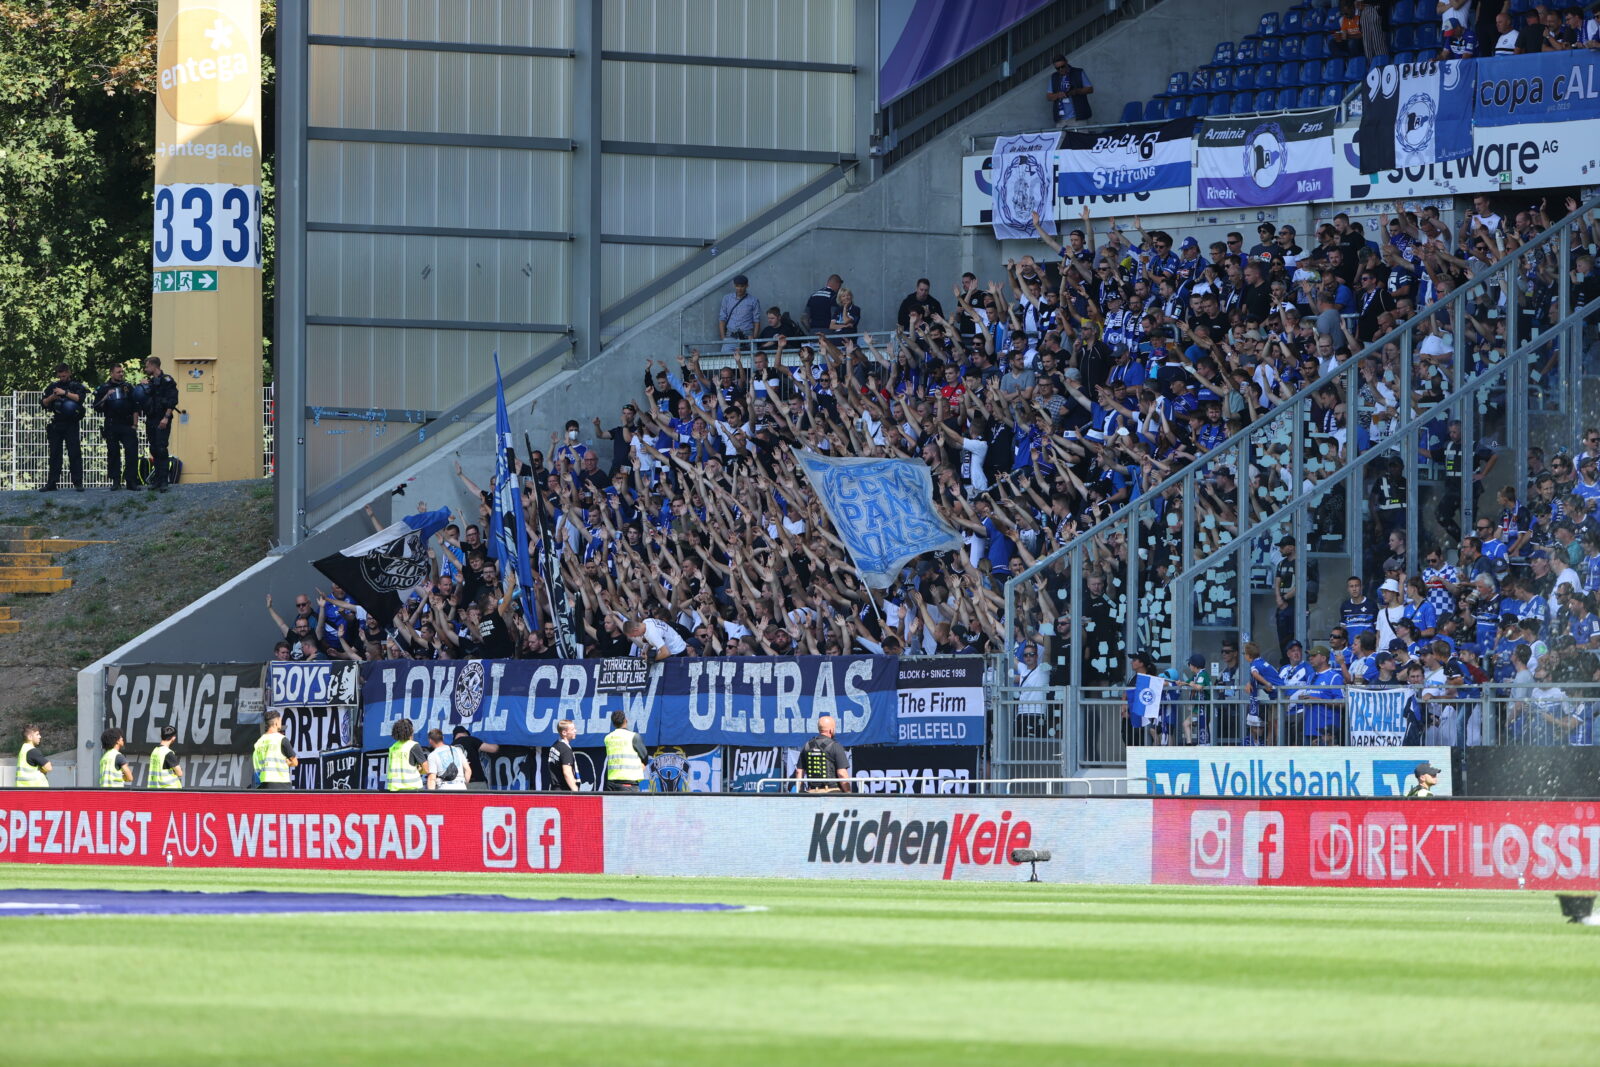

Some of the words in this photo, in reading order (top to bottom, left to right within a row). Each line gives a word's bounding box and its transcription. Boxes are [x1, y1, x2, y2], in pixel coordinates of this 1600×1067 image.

[161, 52, 249, 90] entega
[1366, 64, 1399, 101] 90
[1402, 60, 1437, 80] PLUS
[1480, 75, 1543, 113] copa
[1205, 127, 1246, 140] Arminia
[1298, 121, 1324, 133] Fans
[1542, 140, 1559, 153] AG
[168, 141, 253, 160] entega.de
[1297, 178, 1321, 193] Main
[633, 658, 648, 670] ALS
[899, 669, 921, 679] BLOCK
[921, 669, 926, 679] 6
[930, 669, 950, 679] SINCE
[951, 668, 967, 678] 1998
[272, 666, 330, 703] BOYS
[380, 663, 508, 737] LOKL
[525, 662, 665, 736] CREW
[688, 658, 873, 734] ULTRAS
[900, 692, 926, 713] The
[930, 691, 966, 713] Firm
[111, 672, 238, 745] SPENGE
[282, 707, 342, 752] ORTA
[899, 722, 967, 741] BIELEFELD
[1210, 759, 1361, 796] Volksbank
[0, 809, 152, 857] SPEZIALIST
[162, 811, 218, 858] AUS
[227, 813, 444, 860] WEITERSTADT
[1330, 823, 1456, 876] DIREKT
